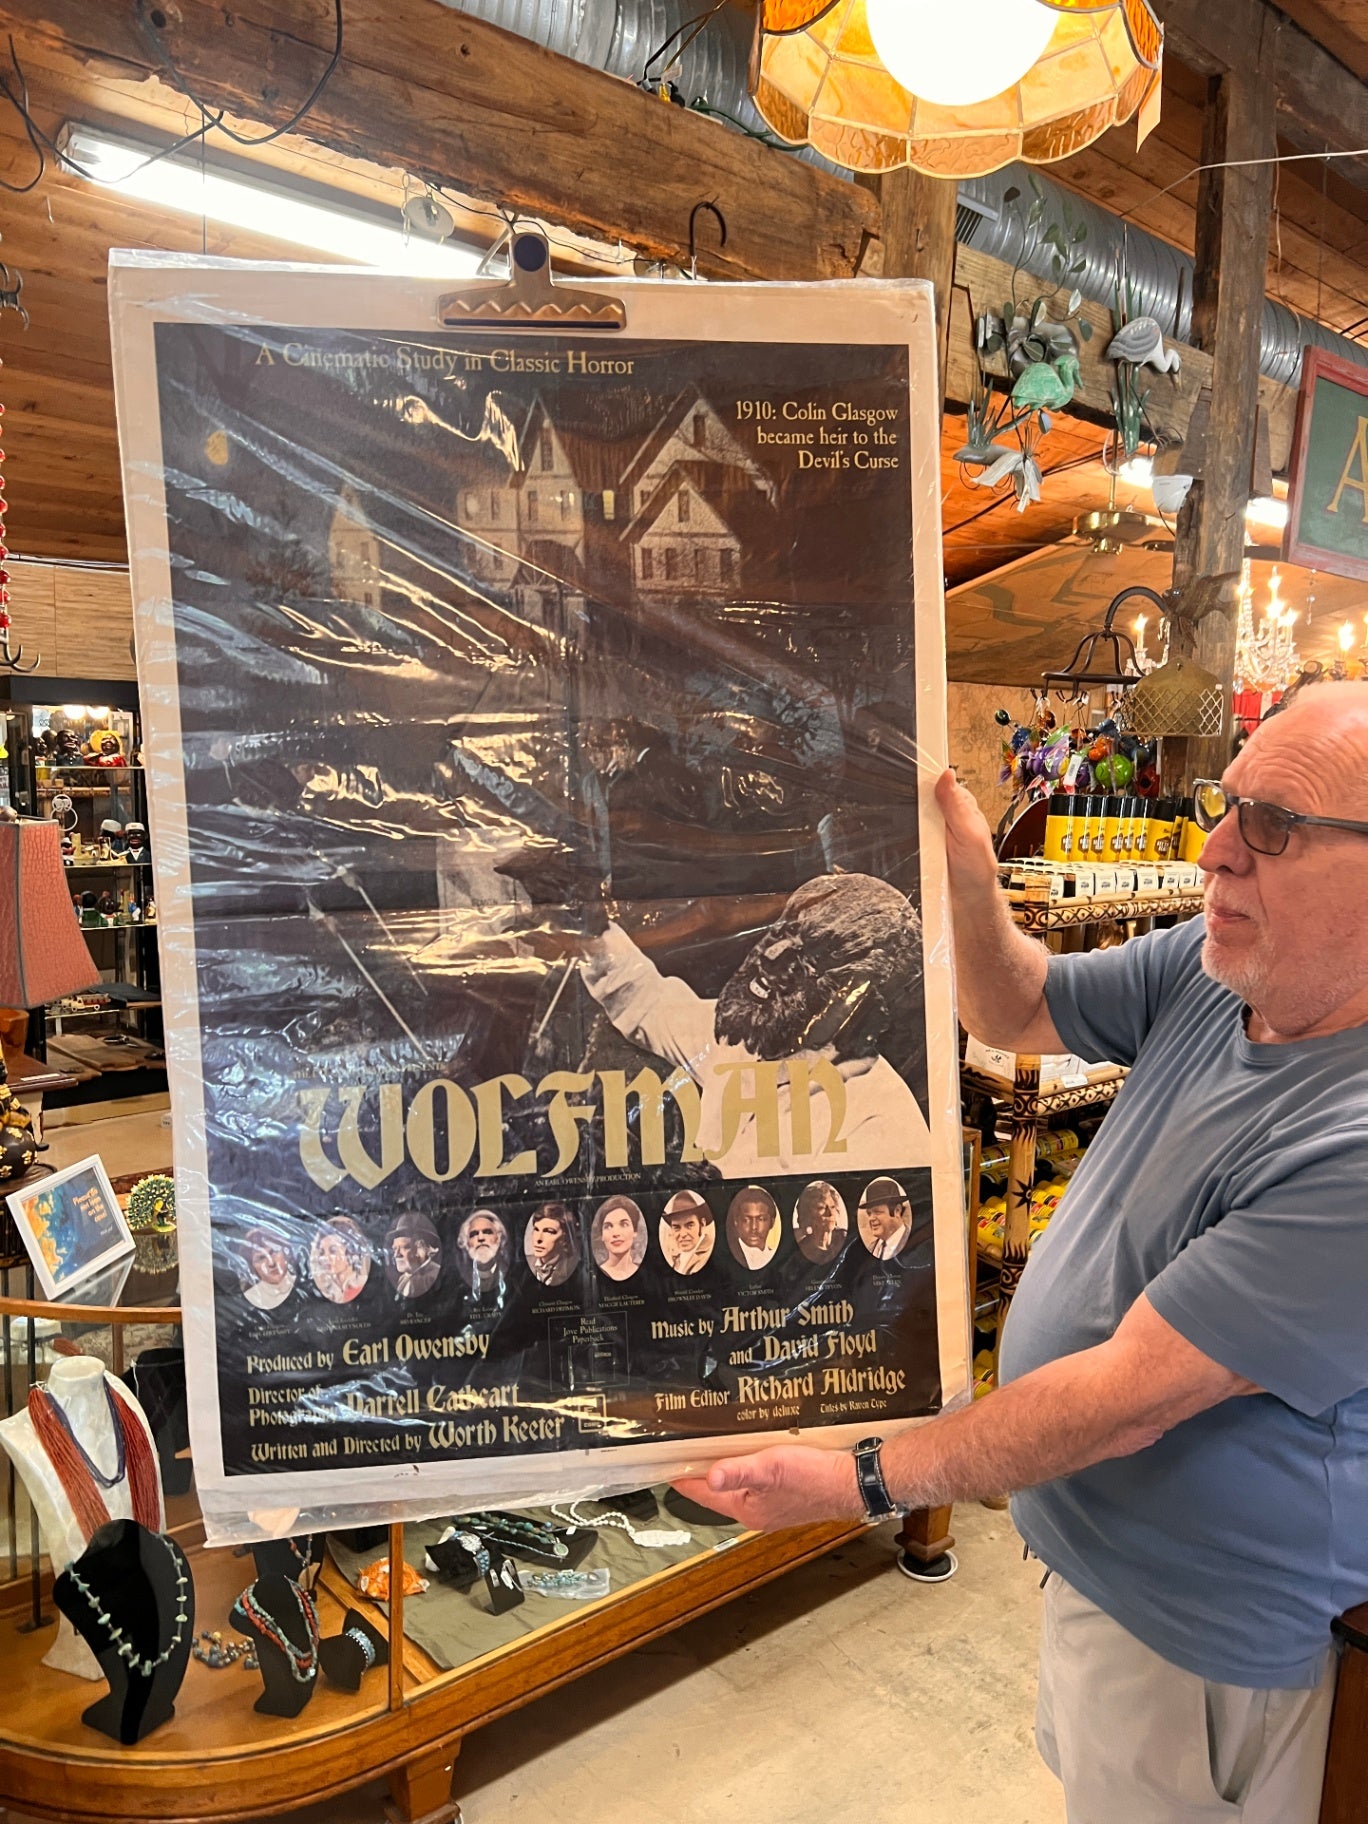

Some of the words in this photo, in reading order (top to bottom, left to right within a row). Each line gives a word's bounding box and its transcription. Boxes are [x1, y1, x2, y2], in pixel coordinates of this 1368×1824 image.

[256, 347, 275, 366] A
[283, 343, 389, 368] Cinematic
[397, 347, 456, 375] Study
[465, 348, 482, 371] in
[489, 349, 560, 374] Classic
[567, 351, 635, 375] Horror
[736, 400, 776, 420] 1910:
[782, 402, 826, 421] Colin
[832, 402, 898, 426] Glasgow
[757, 426, 814, 445] became
[819, 426, 847, 445] heir
[852, 431, 868, 445] to
[873, 427, 897, 445] the
[798, 450, 850, 469] Devil's
[854, 451, 899, 469] Curse
[300, 1057, 848, 1192] WOLFMAN
[651, 1320, 694, 1339] Music
[698, 1318, 715, 1336] by
[720, 1305, 787, 1334] Arthur
[798, 1300, 854, 1326] Smith
[247, 1354, 313, 1374] Produced
[316, 1351, 334, 1370] by
[342, 1337, 389, 1366] Earl
[395, 1331, 490, 1362] Owensby
[728, 1347, 753, 1365] and
[763, 1333, 818, 1361] David
[825, 1329, 877, 1357] Floyd
[248, 1385, 306, 1405] Director
[346, 1389, 420, 1418] Darrell
[653, 1392, 686, 1412] Film
[690, 1389, 730, 1409] Editor
[737, 1376, 814, 1403] Richard
[820, 1366, 906, 1395] Aldridge
[758, 1407, 770, 1420] by
[773, 1405, 800, 1418] deluxe
[251, 1441, 307, 1462] Written
[312, 1438, 338, 1458] and
[343, 1435, 400, 1455] Directed
[405, 1434, 422, 1452] by
[428, 1420, 497, 1450] Worth
[503, 1415, 565, 1443] Keeter
